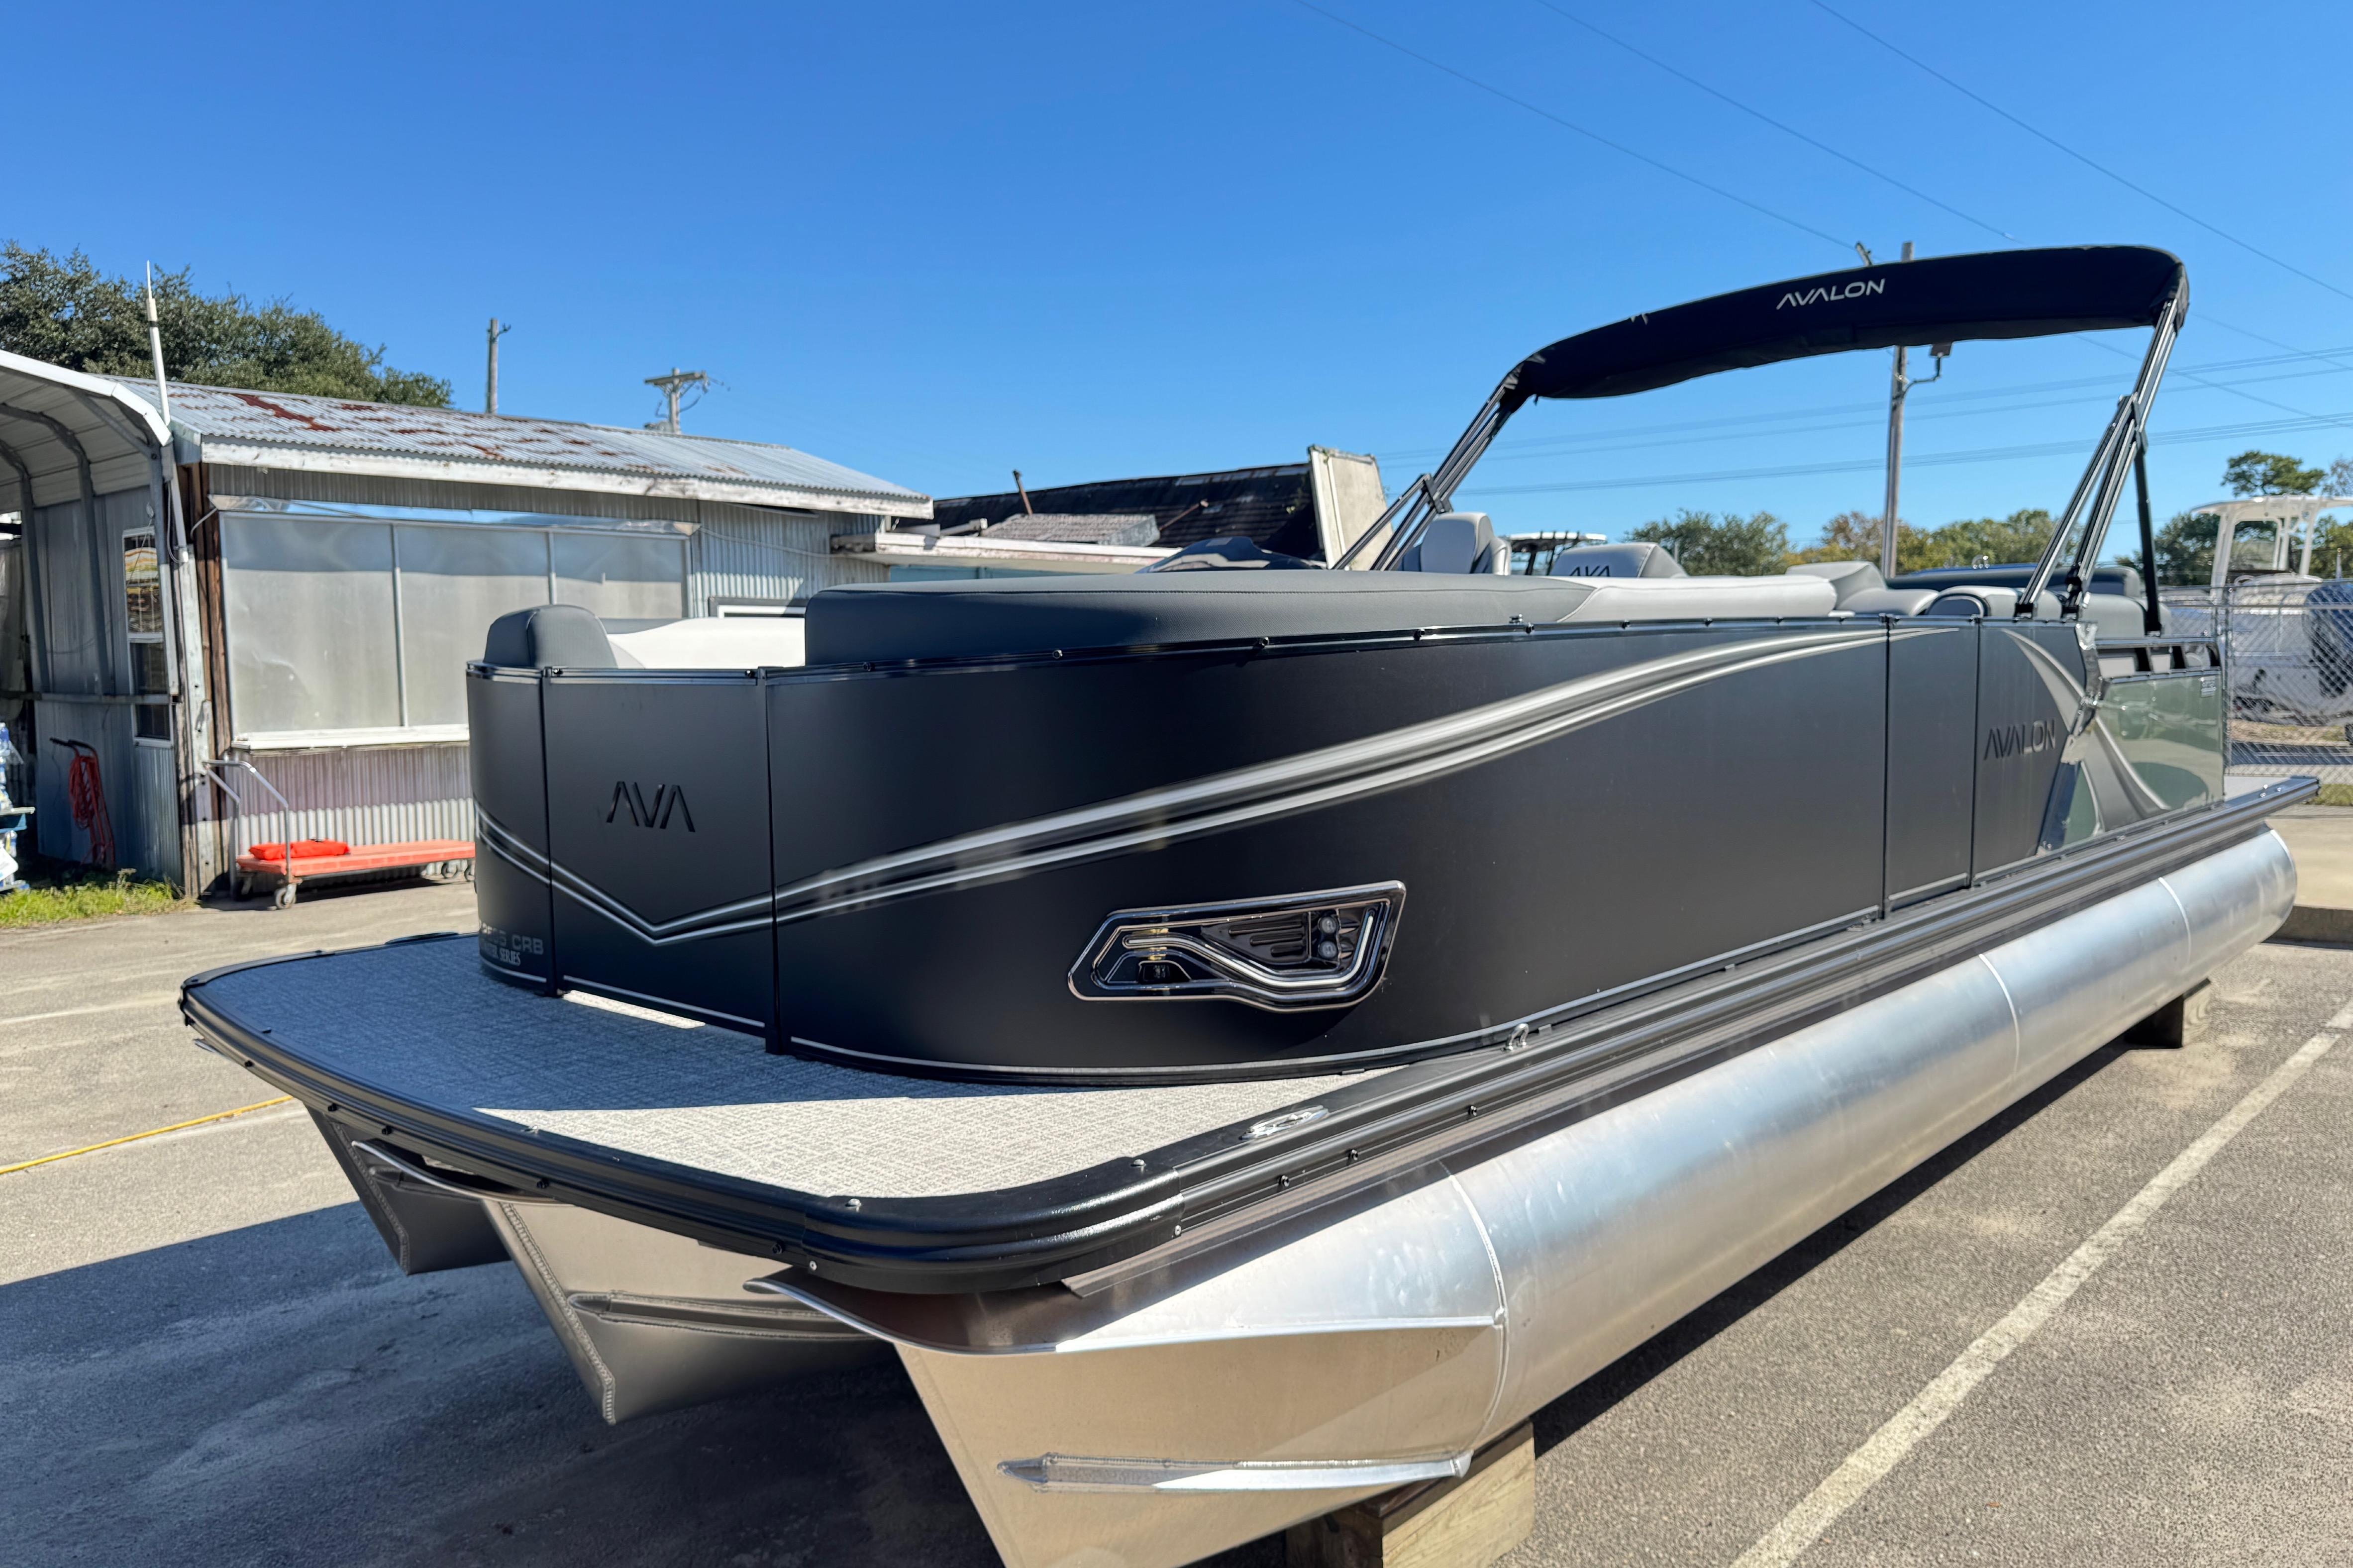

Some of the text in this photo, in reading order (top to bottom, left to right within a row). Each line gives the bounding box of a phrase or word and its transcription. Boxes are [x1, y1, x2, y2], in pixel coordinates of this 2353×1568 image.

[1776, 278, 1886, 310] AVALON
[1569, 565, 1610, 577] AVA
[1983, 719, 2056, 760] AVALON
[606, 781, 696, 833] AVA
[512, 934, 544, 955] CRB
